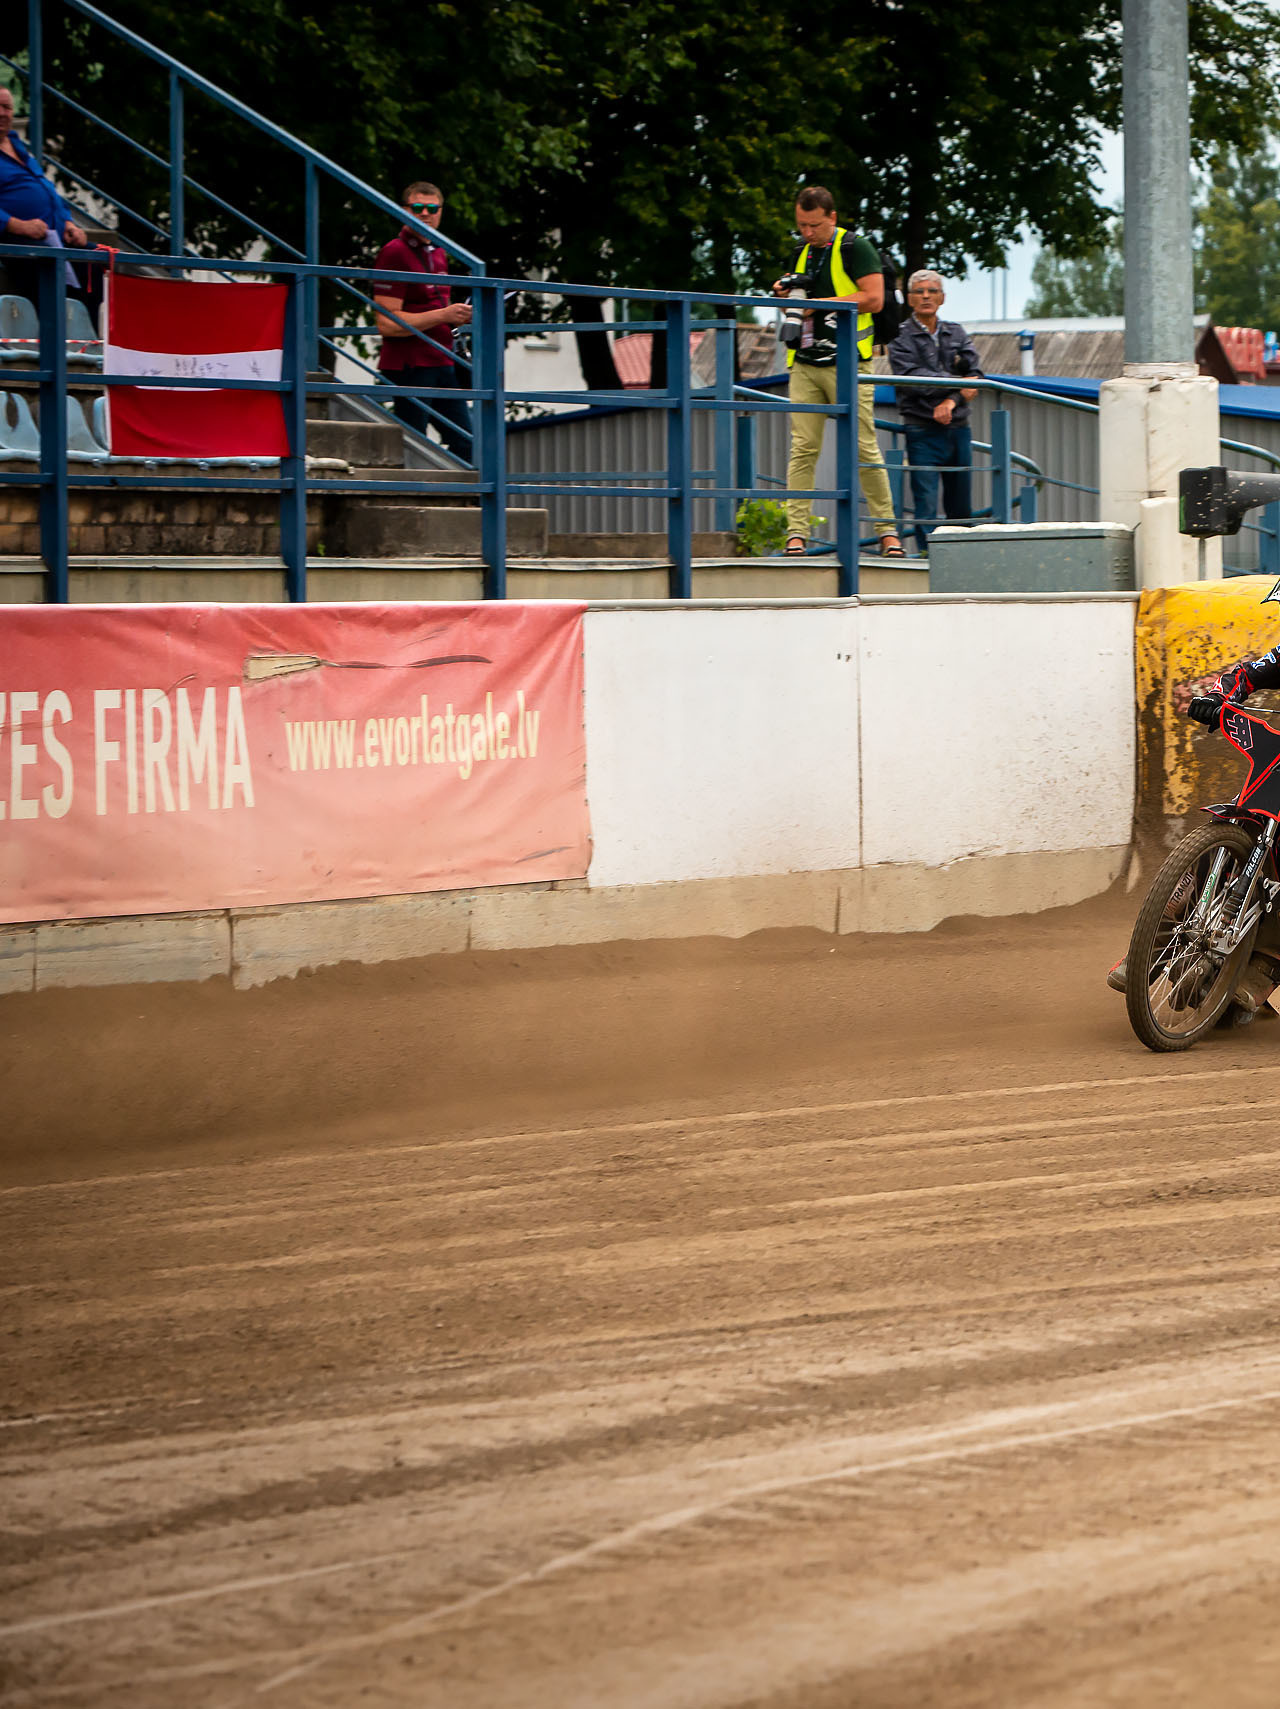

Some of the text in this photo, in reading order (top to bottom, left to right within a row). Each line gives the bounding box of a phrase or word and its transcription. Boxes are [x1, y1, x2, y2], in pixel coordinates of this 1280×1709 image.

[0, 686, 256, 820] ES FIRMA
[285, 690, 541, 780] www.evorlatgale.lv
[1245, 846, 1262, 878] FALCON
